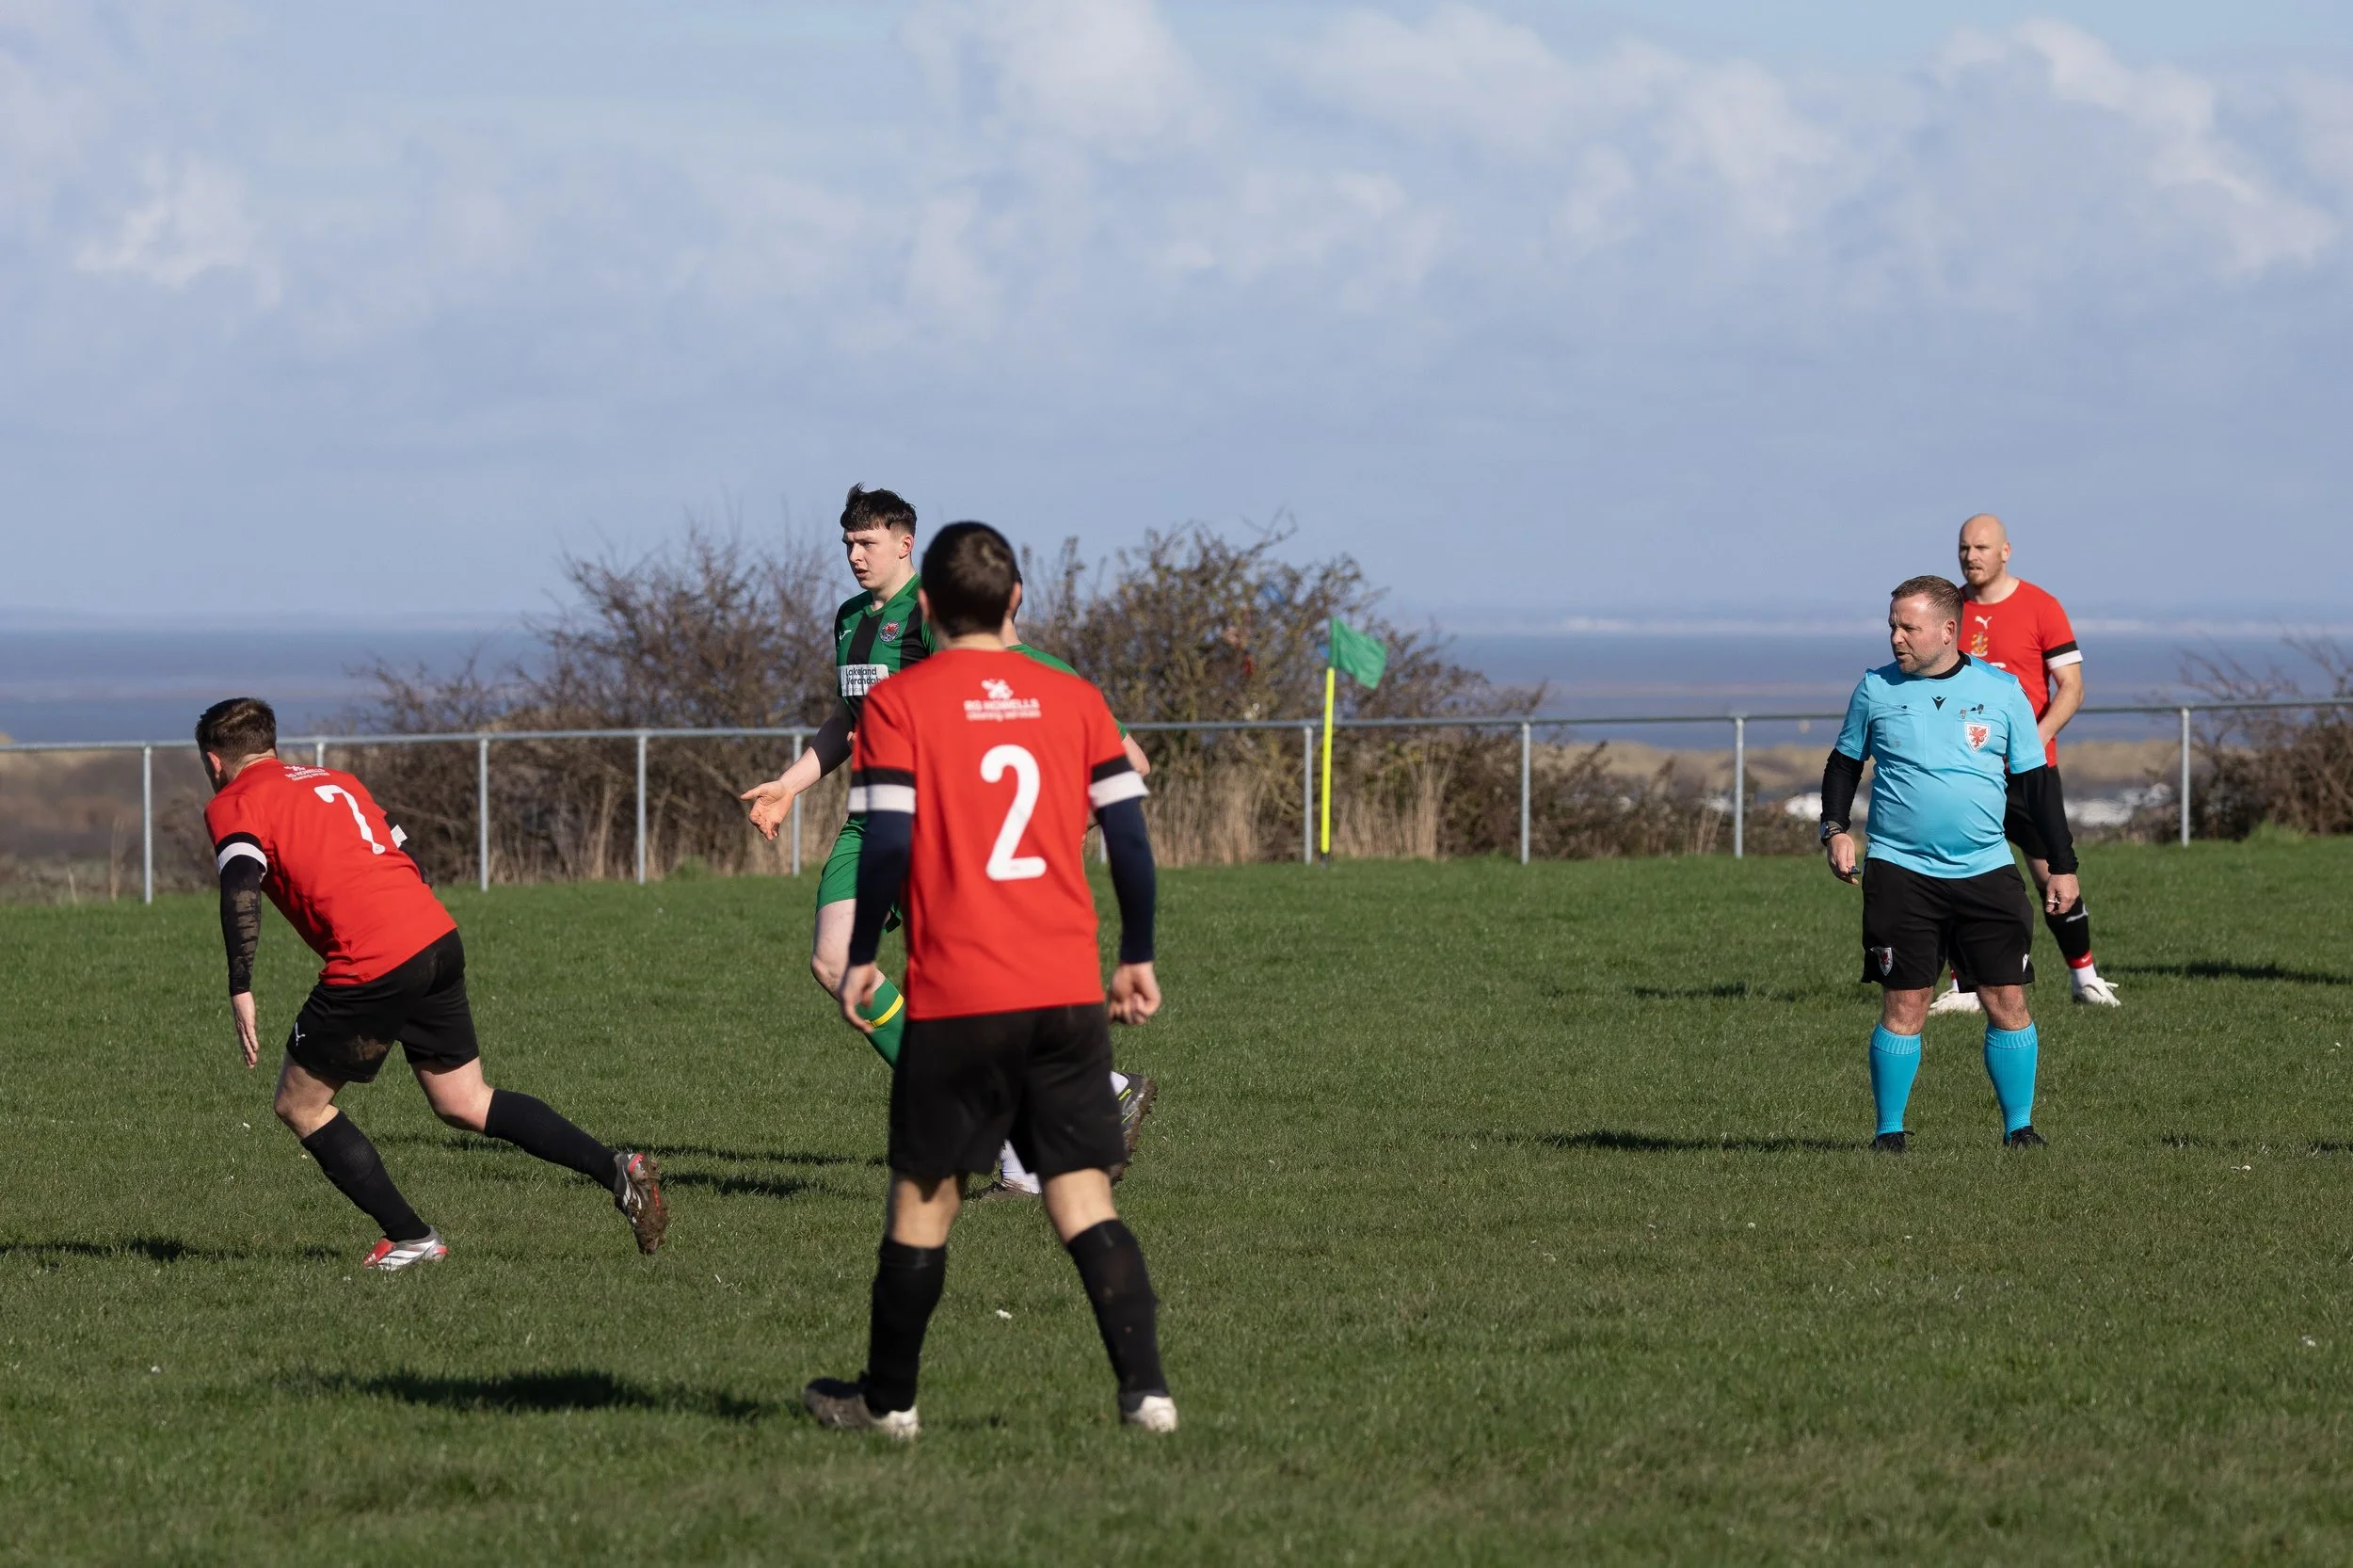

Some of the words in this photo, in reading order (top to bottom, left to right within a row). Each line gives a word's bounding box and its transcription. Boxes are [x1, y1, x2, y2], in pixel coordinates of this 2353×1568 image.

[845, 666, 877, 677] Lakeland
[313, 784, 386, 856] 7
[980, 744, 1047, 881] 2
